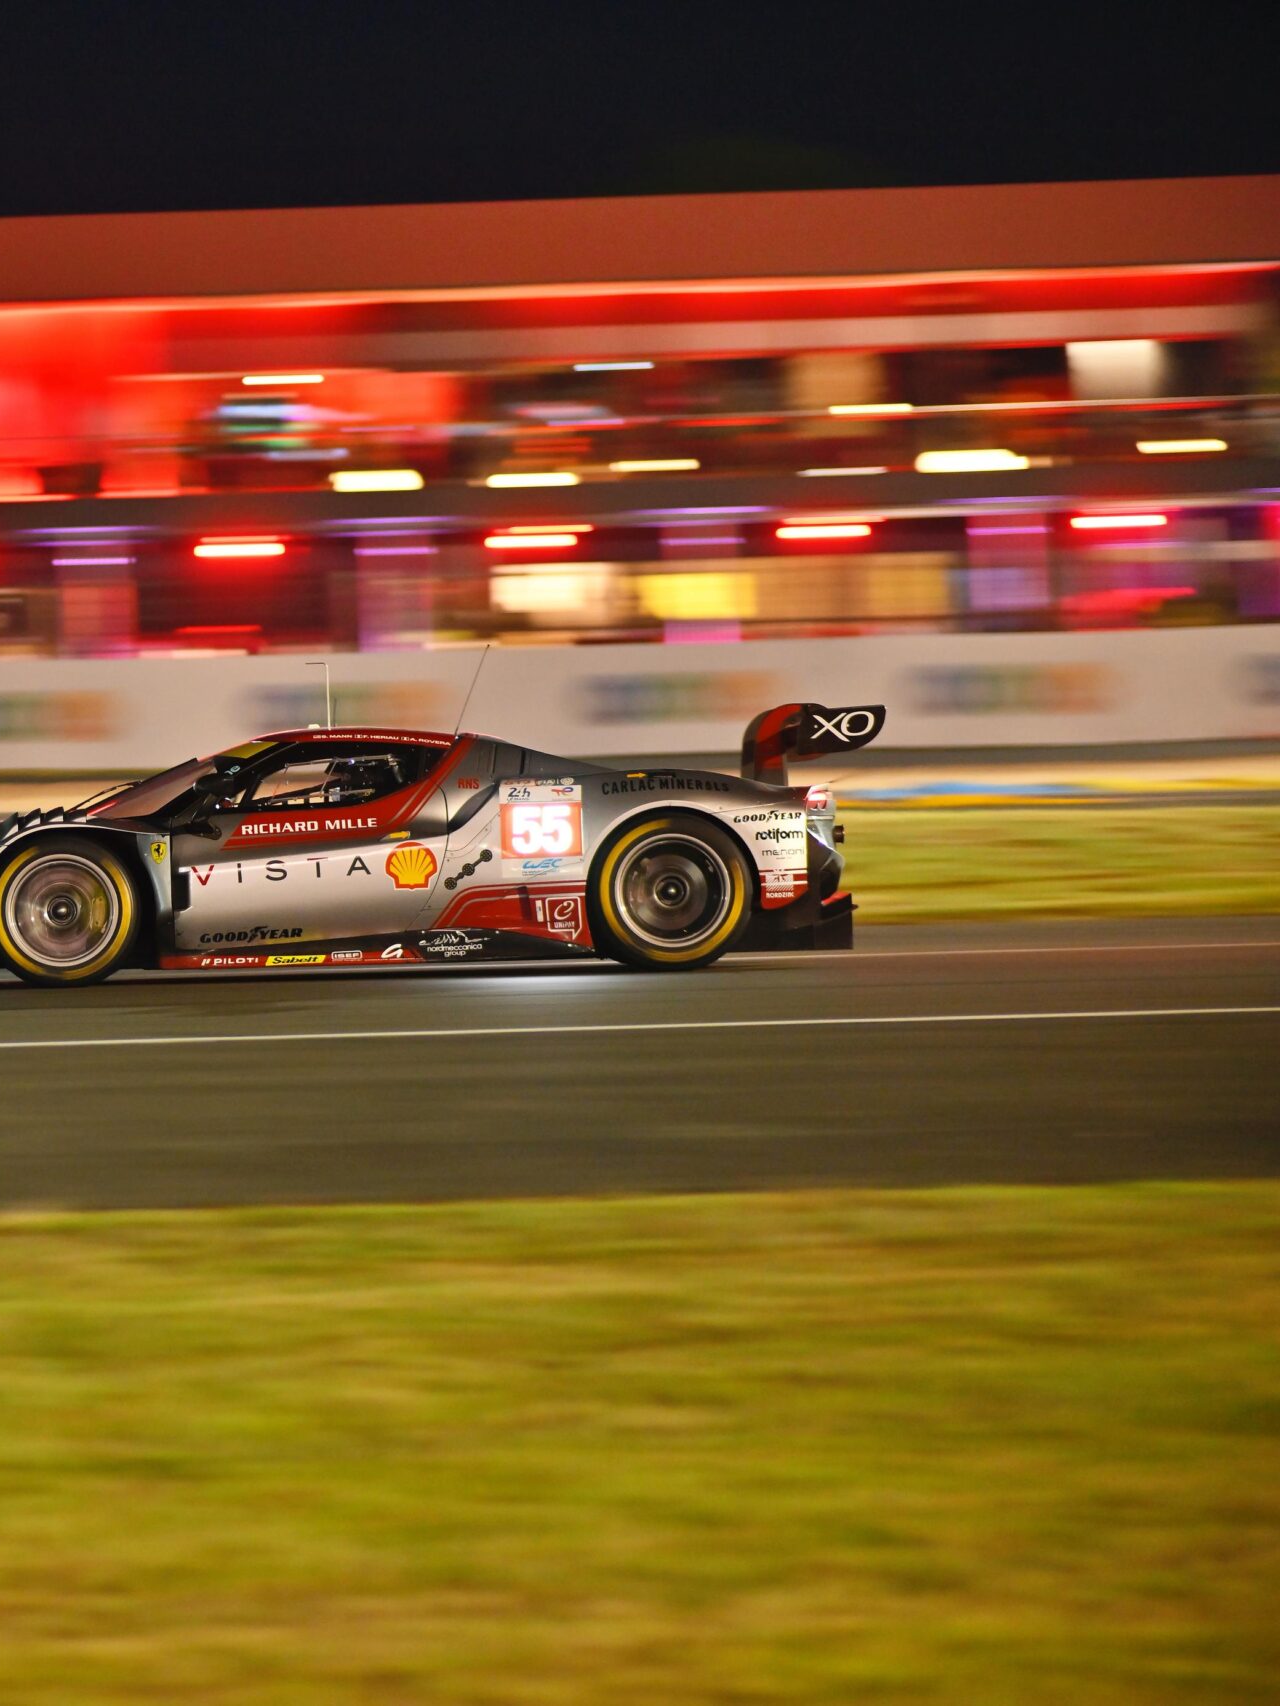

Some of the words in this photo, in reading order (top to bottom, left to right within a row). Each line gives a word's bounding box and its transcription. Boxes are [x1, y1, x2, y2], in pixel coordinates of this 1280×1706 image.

[810, 711, 875, 742] XO
[601, 779, 656, 796] CARLAC
[241, 820, 319, 836] RICHARD
[325, 817, 378, 831] MILLE
[511, 805, 573, 854] 55
[191, 856, 372, 886] VISTA
[213, 957, 259, 966] PILOTI
[272, 956, 319, 964] Sabelt
